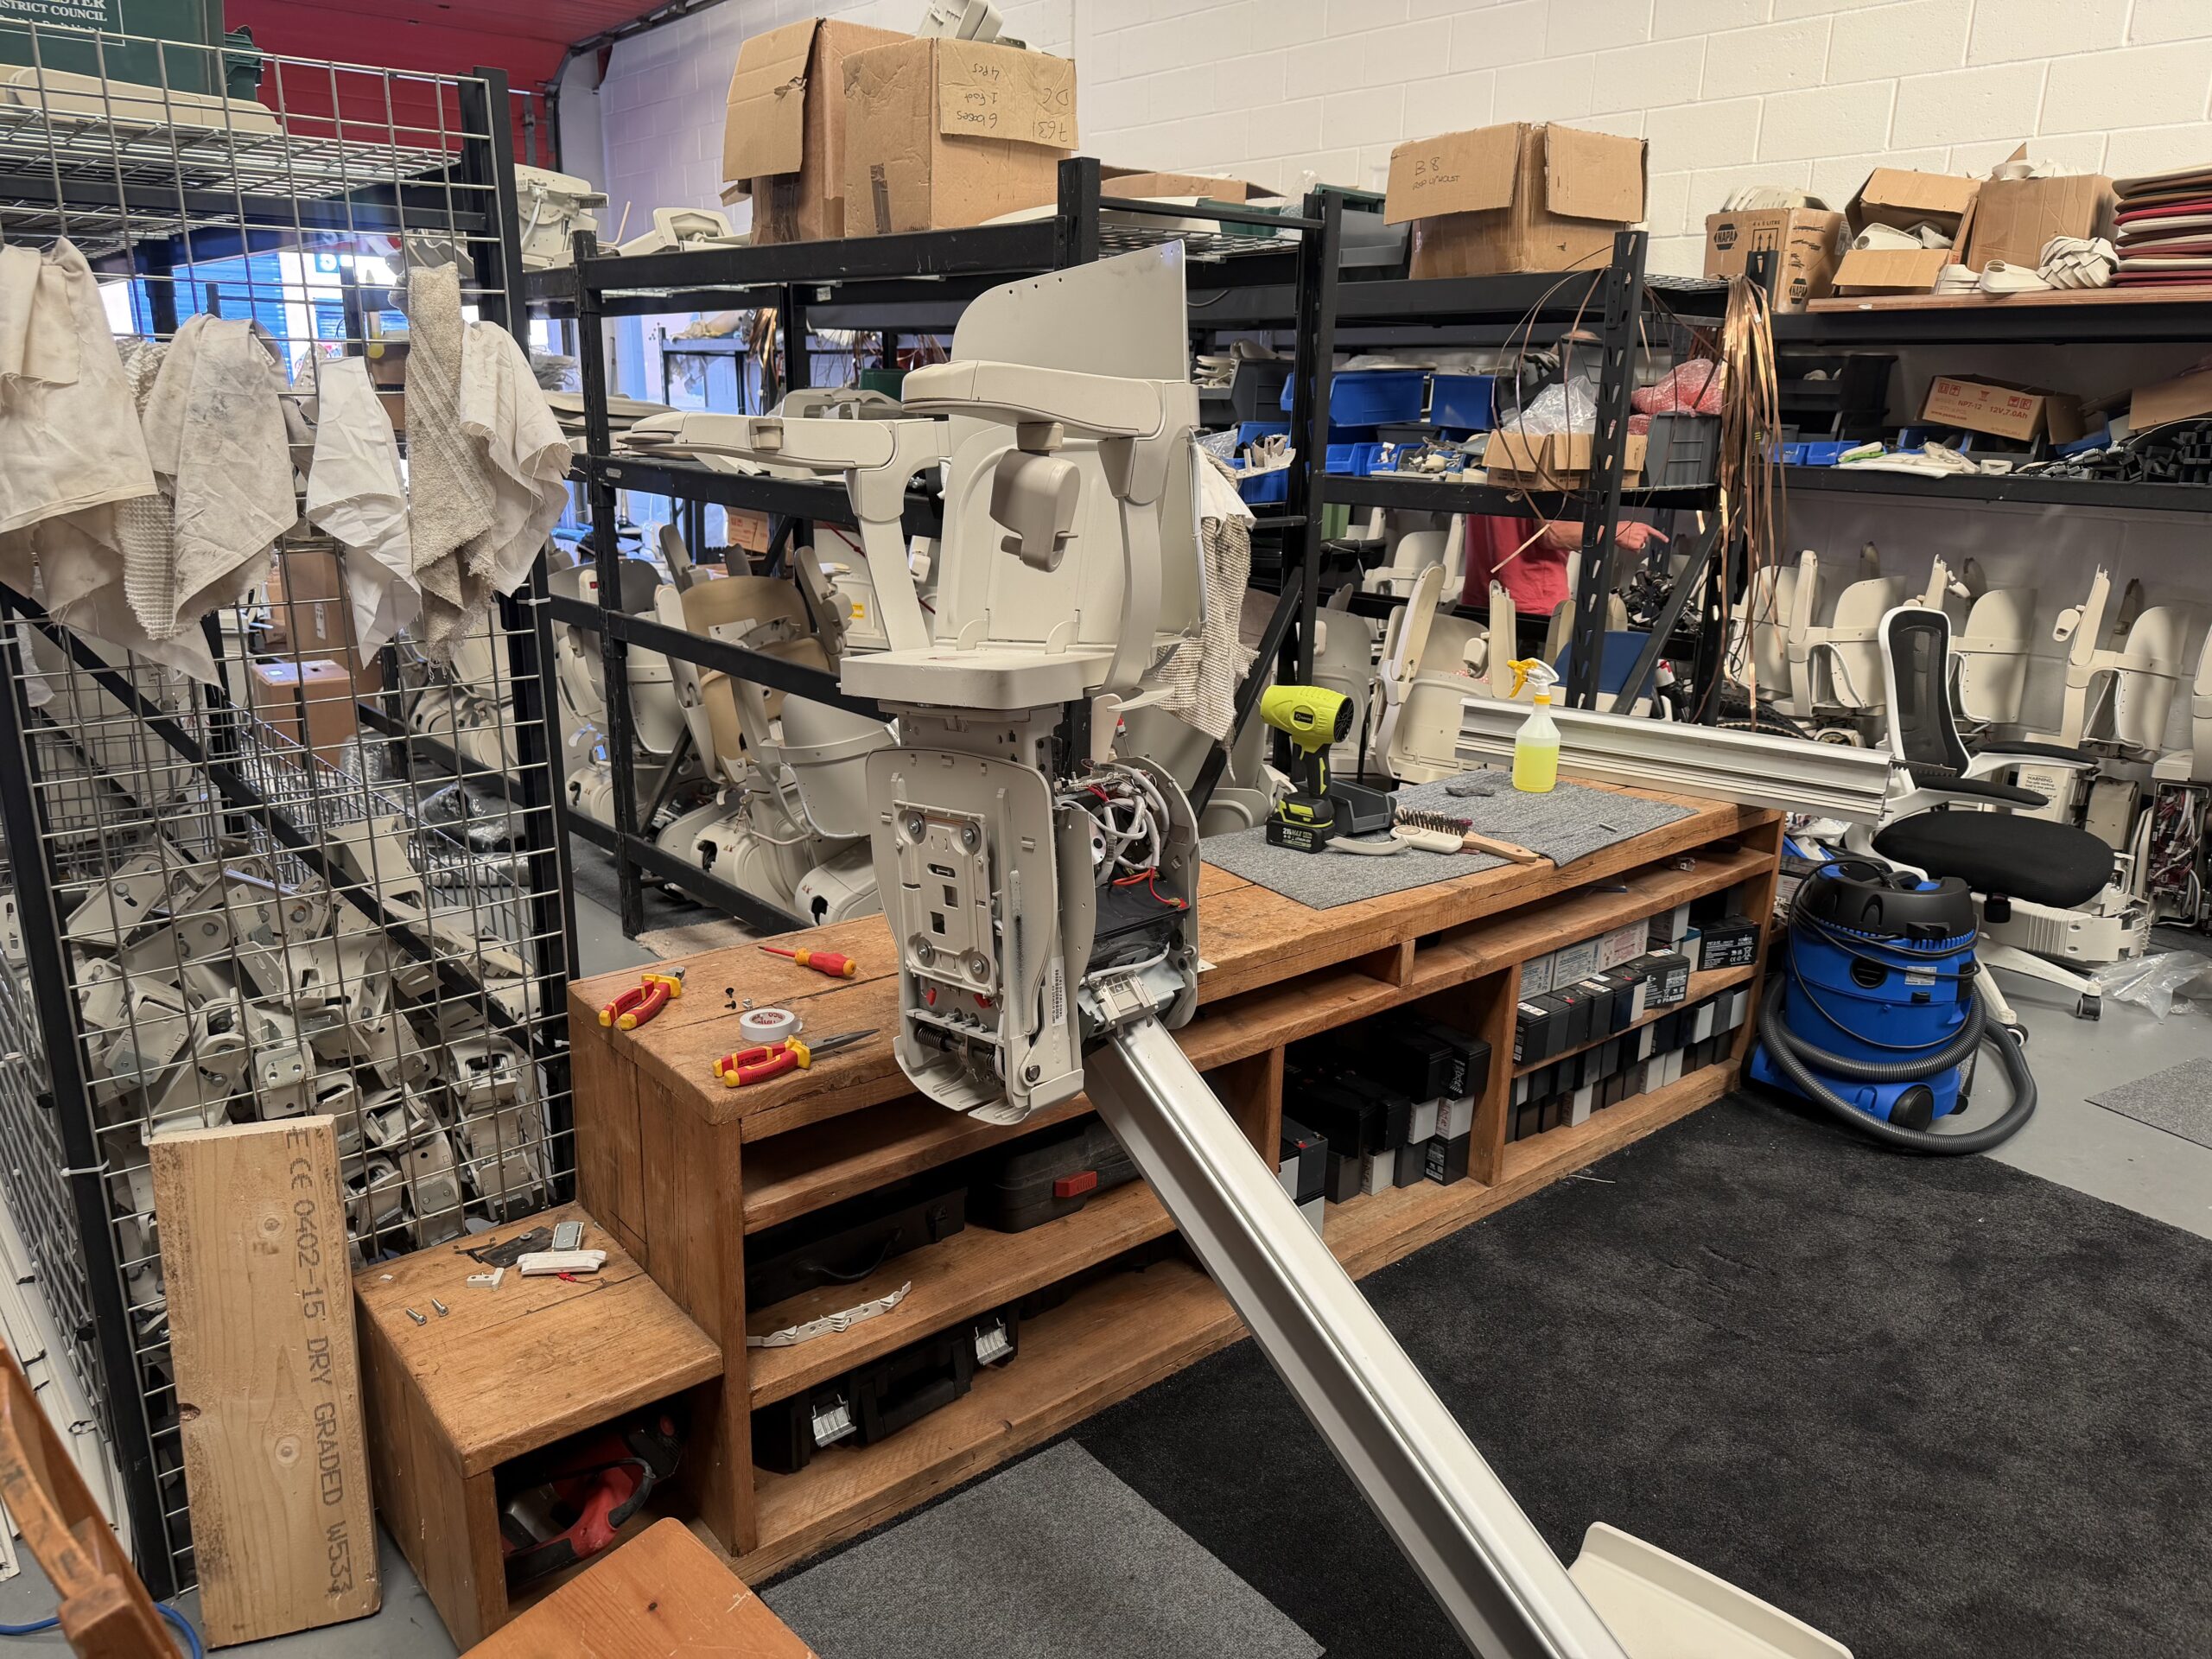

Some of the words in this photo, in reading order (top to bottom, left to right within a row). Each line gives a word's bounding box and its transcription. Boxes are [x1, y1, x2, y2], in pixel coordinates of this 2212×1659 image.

[50, 5, 107, 22] COUNCIL
[991, 66, 1000, 81] 4
[991, 92, 998, 104] 1
[988, 112, 998, 129] 6
[1032, 120, 1068, 143] 7631
[1414, 161, 1427, 176] B
[1430, 156, 1440, 171] 8
[1716, 229, 1735, 244] NAPA
[1790, 285, 1804, 299] NAPA
[1957, 400, 1983, 410] NP7-12
[306, 1336, 333, 1386] DRY
[314, 1401, 344, 1507] GRADED
